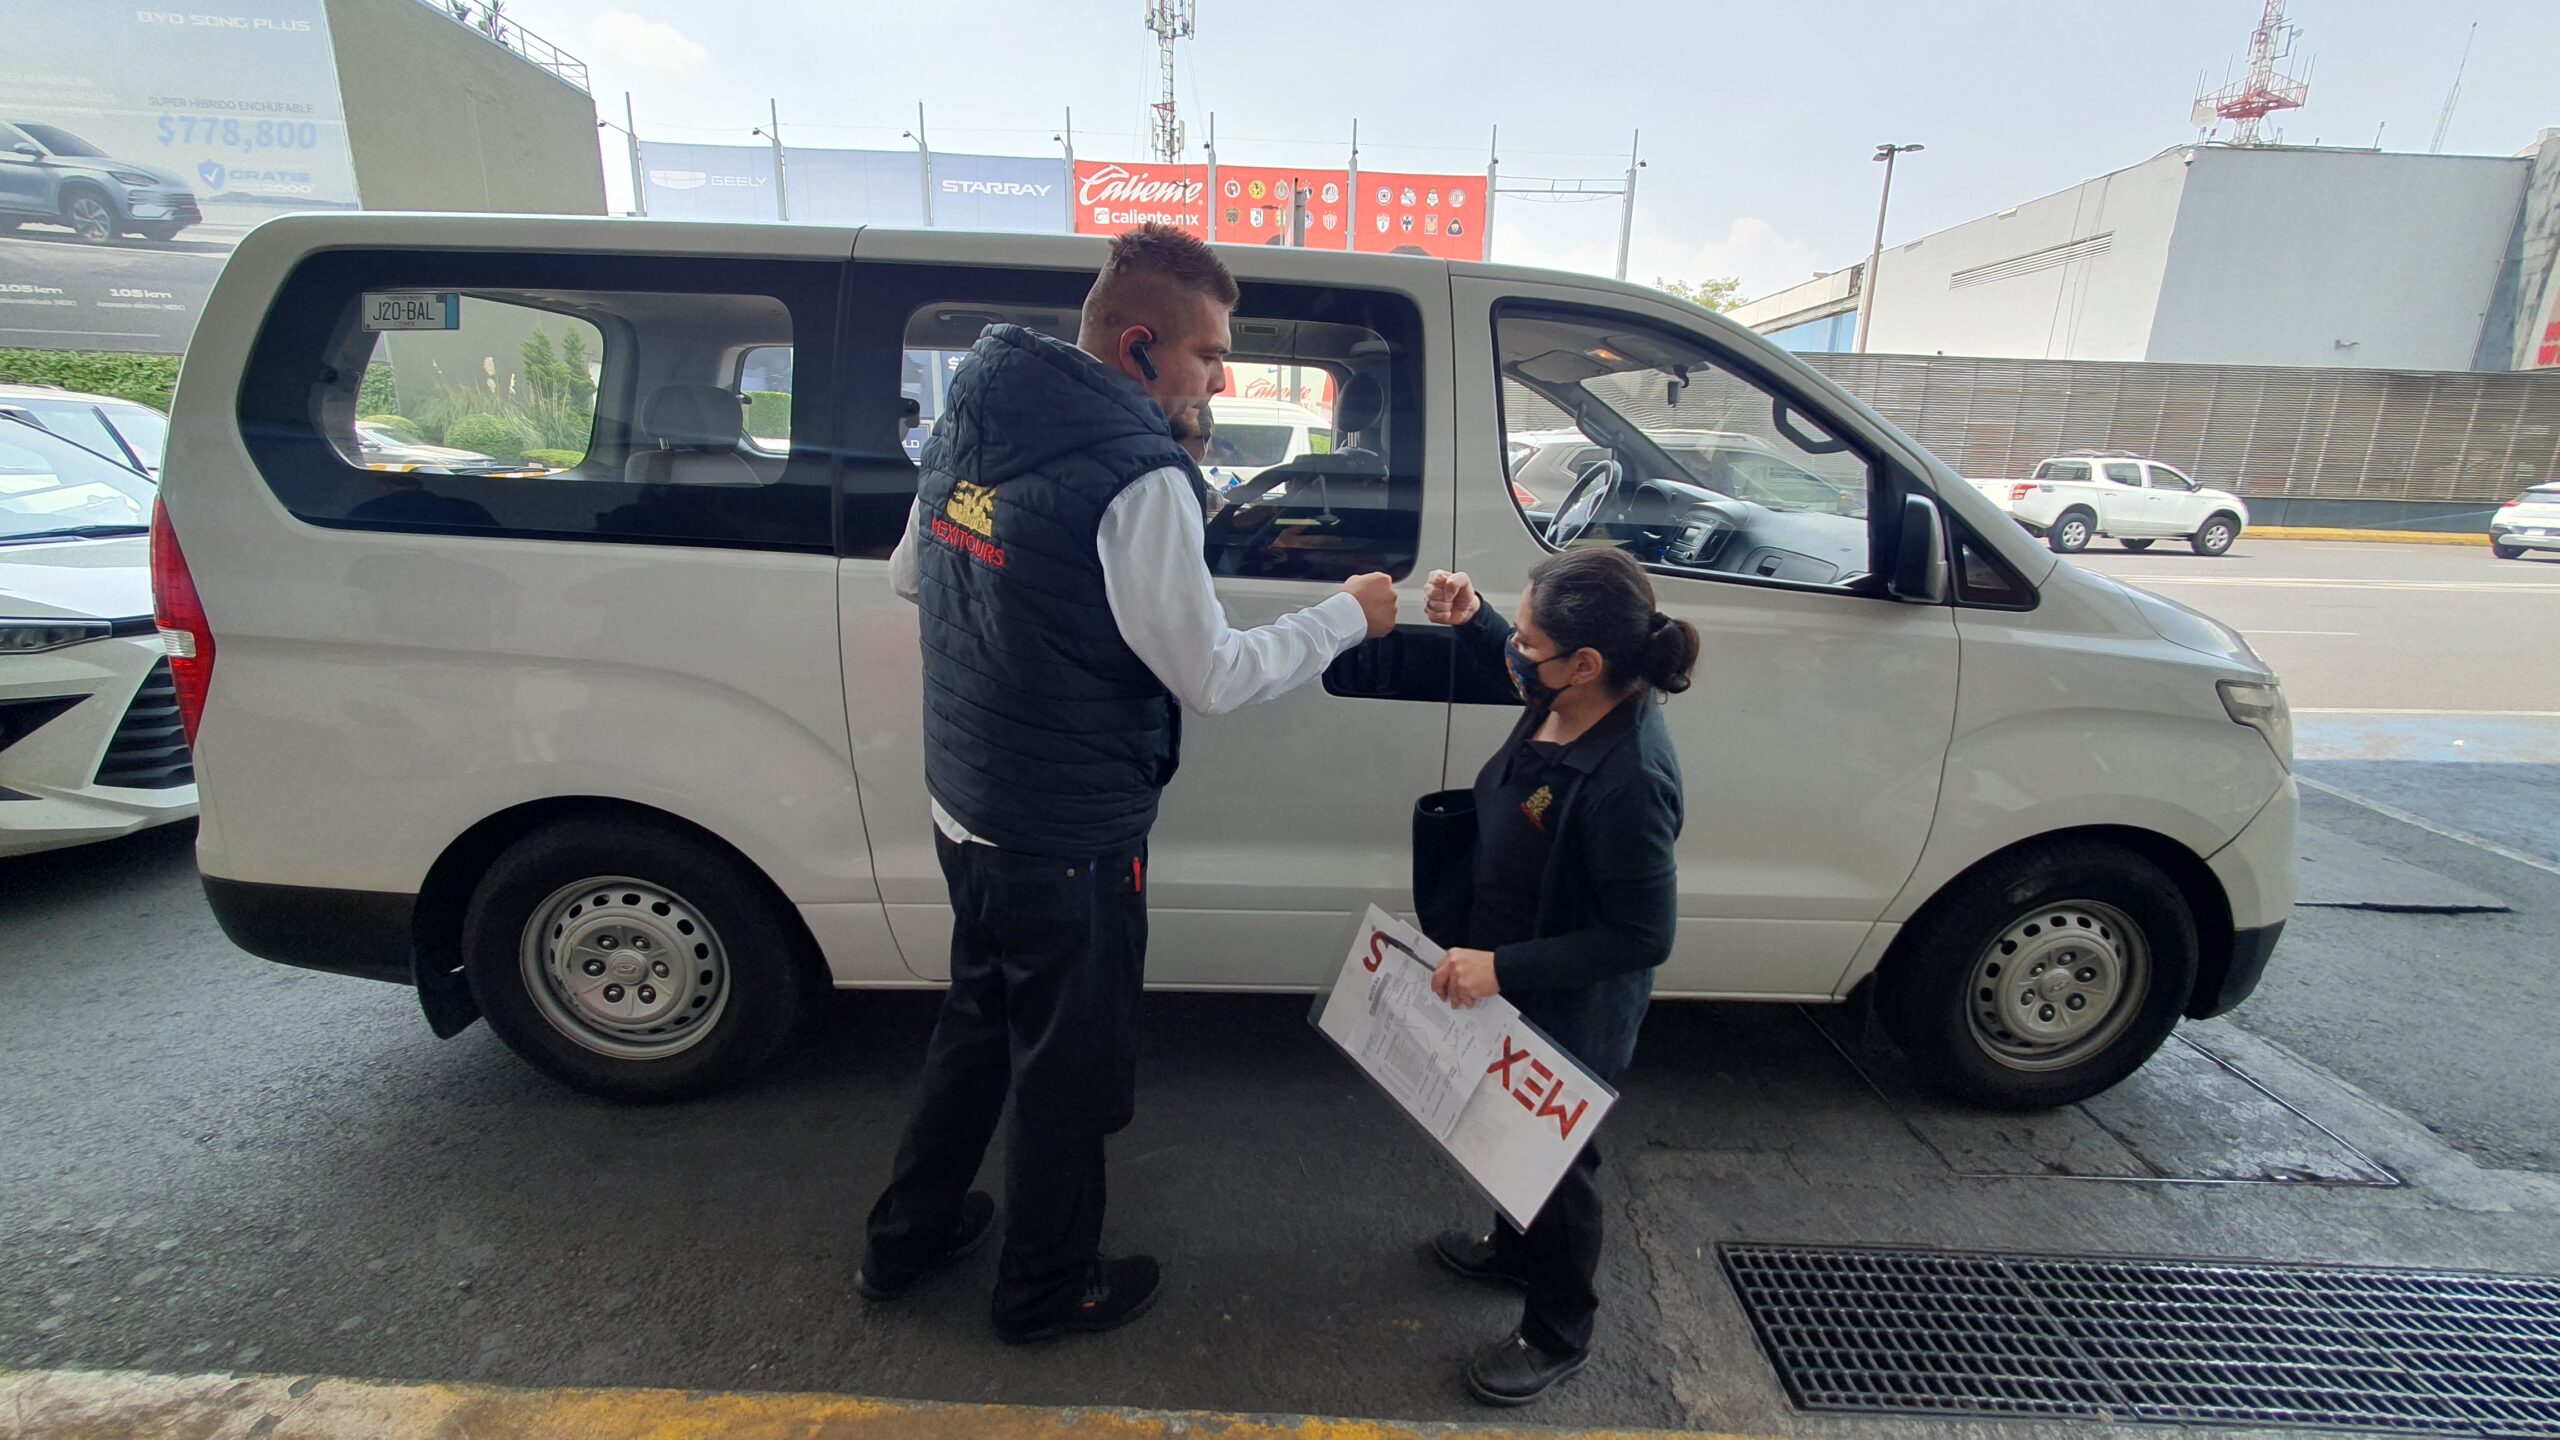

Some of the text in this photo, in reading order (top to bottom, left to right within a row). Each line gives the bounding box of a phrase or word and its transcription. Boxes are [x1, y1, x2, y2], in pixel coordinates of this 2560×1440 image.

[137, 10, 311, 32] BYD SONG PLUS
[238, 100, 314, 114] ENCHUFABLE
[157, 111, 317, 154] $778,800
[710, 175, 767, 188] GEELY
[942, 179, 1052, 197] STARRAY
[1111, 208, 1200, 226] caliente.mx
[34, 285, 63, 294] km
[109, 288, 172, 299] 105 km
[372, 301, 435, 321] J20-BAL
[930, 516, 1006, 568] MEXITOURS
[1486, 1033, 1590, 1142] MEX
